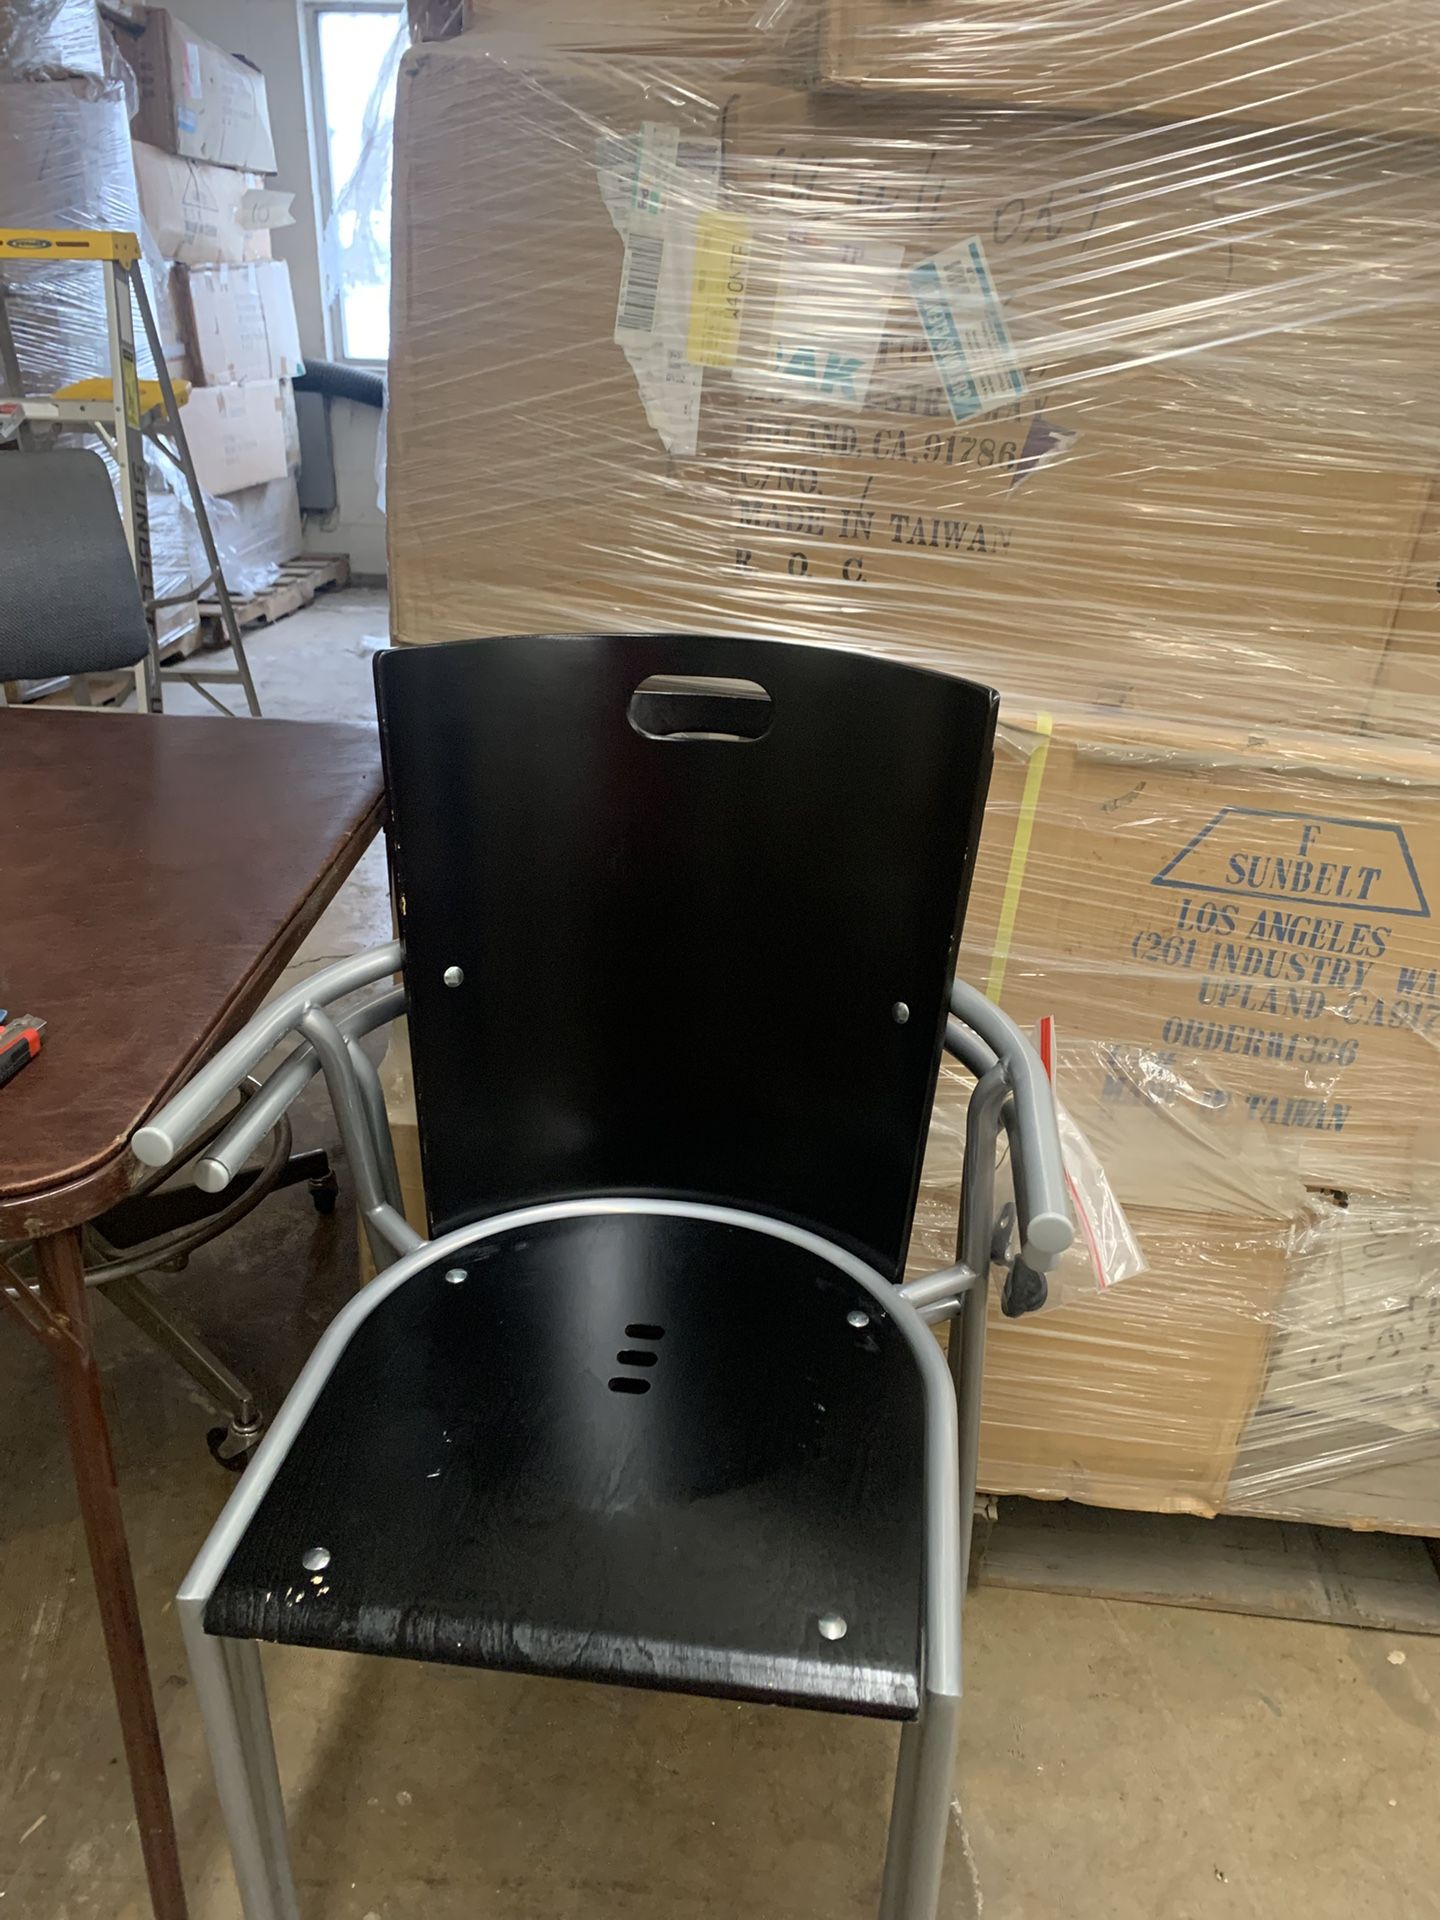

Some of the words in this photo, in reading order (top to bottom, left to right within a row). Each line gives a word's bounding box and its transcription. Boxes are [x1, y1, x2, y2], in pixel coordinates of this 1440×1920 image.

[737, 500, 826, 536] MADE
[838, 509, 875, 540] IN
[890, 513, 1013, 554] TAIWAN
[1225, 853, 1381, 901] SUNBELT
[1177, 899, 1240, 936] LOS
[1246, 909, 1392, 959] ANGELES
[1208, 942, 1374, 993] INDUSTRY
[1198, 976, 1326, 1020] UPLAND
